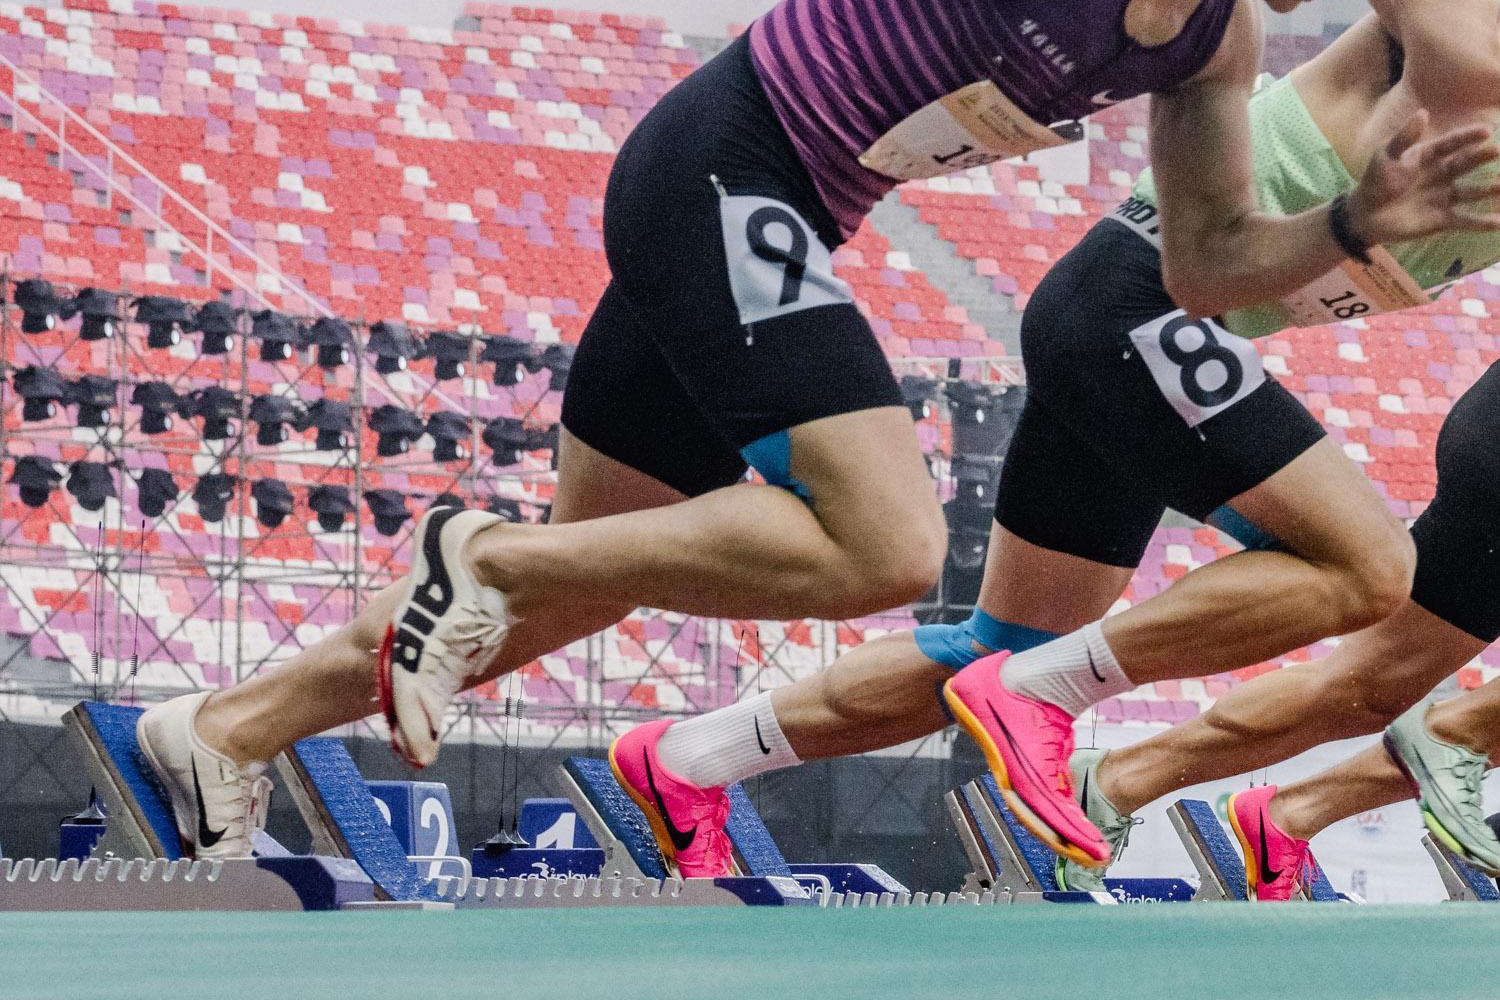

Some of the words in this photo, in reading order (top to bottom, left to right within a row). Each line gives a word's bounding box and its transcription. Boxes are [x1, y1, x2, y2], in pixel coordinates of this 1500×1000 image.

[746, 206, 808, 306] 9
[1159, 315, 1243, 407] 8
[420, 797, 449, 881] 2
[536, 812, 577, 848] 1
